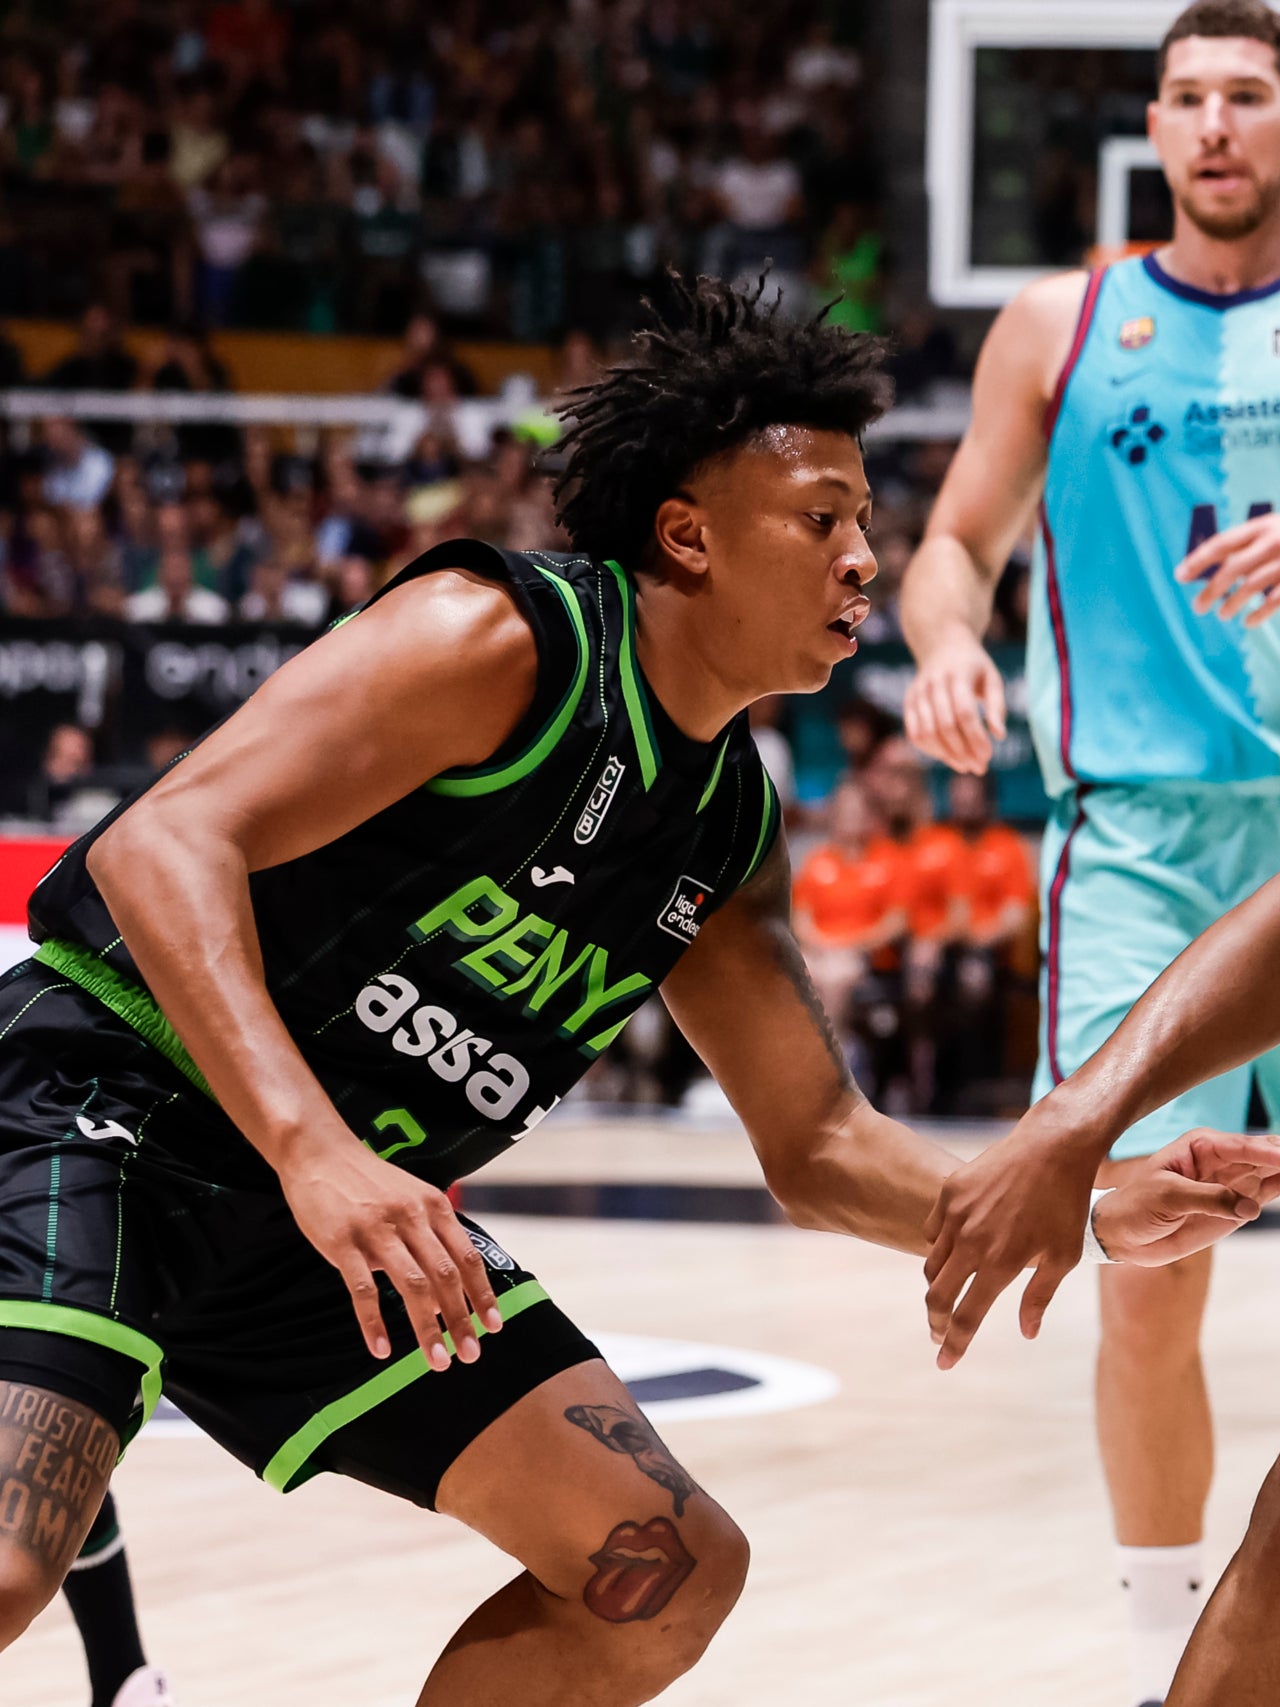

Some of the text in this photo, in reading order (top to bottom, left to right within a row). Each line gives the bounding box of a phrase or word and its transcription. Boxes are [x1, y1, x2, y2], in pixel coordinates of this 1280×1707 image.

[674, 894, 697, 916] liga
[667, 911, 701, 937] endes
[16, 1432, 93, 1511] FEAR
